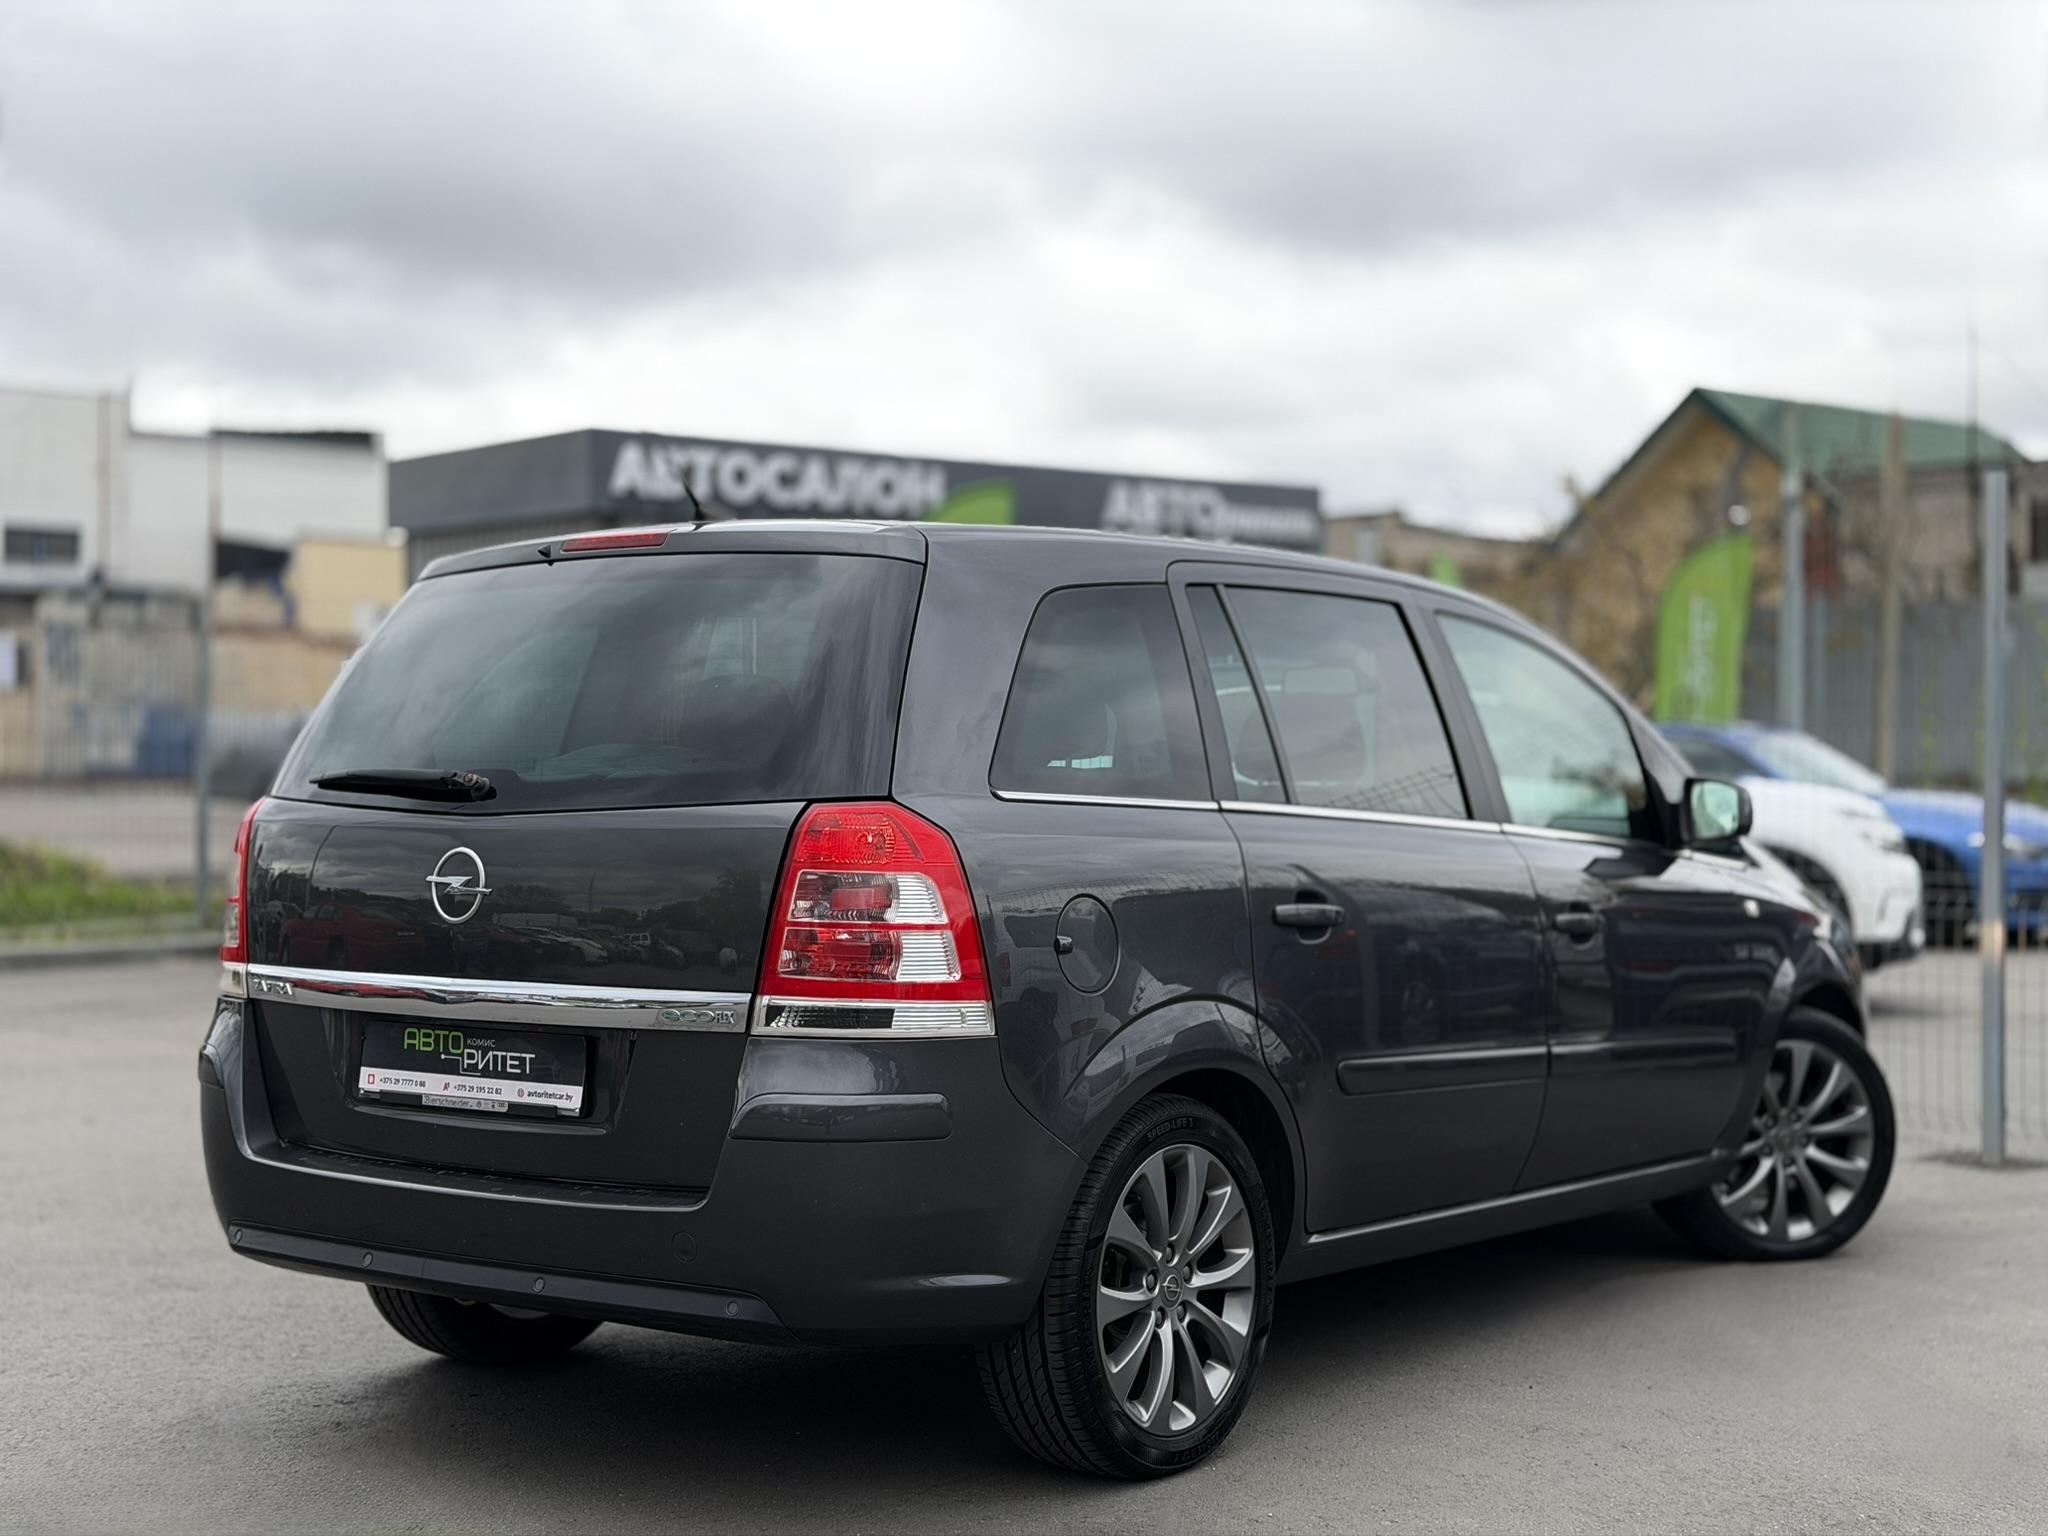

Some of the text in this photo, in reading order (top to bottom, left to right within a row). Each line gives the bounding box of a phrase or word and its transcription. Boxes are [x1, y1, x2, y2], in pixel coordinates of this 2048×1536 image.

[404, 1027, 464, 1054] АВТО
[466, 1038, 496, 1048] КОМИС
[463, 1048, 536, 1075] РИТЕТ
[527, 1090, 573, 1102] avtoritetcar.by
[1147, 1117, 1187, 1142] SPEED-LIFE
